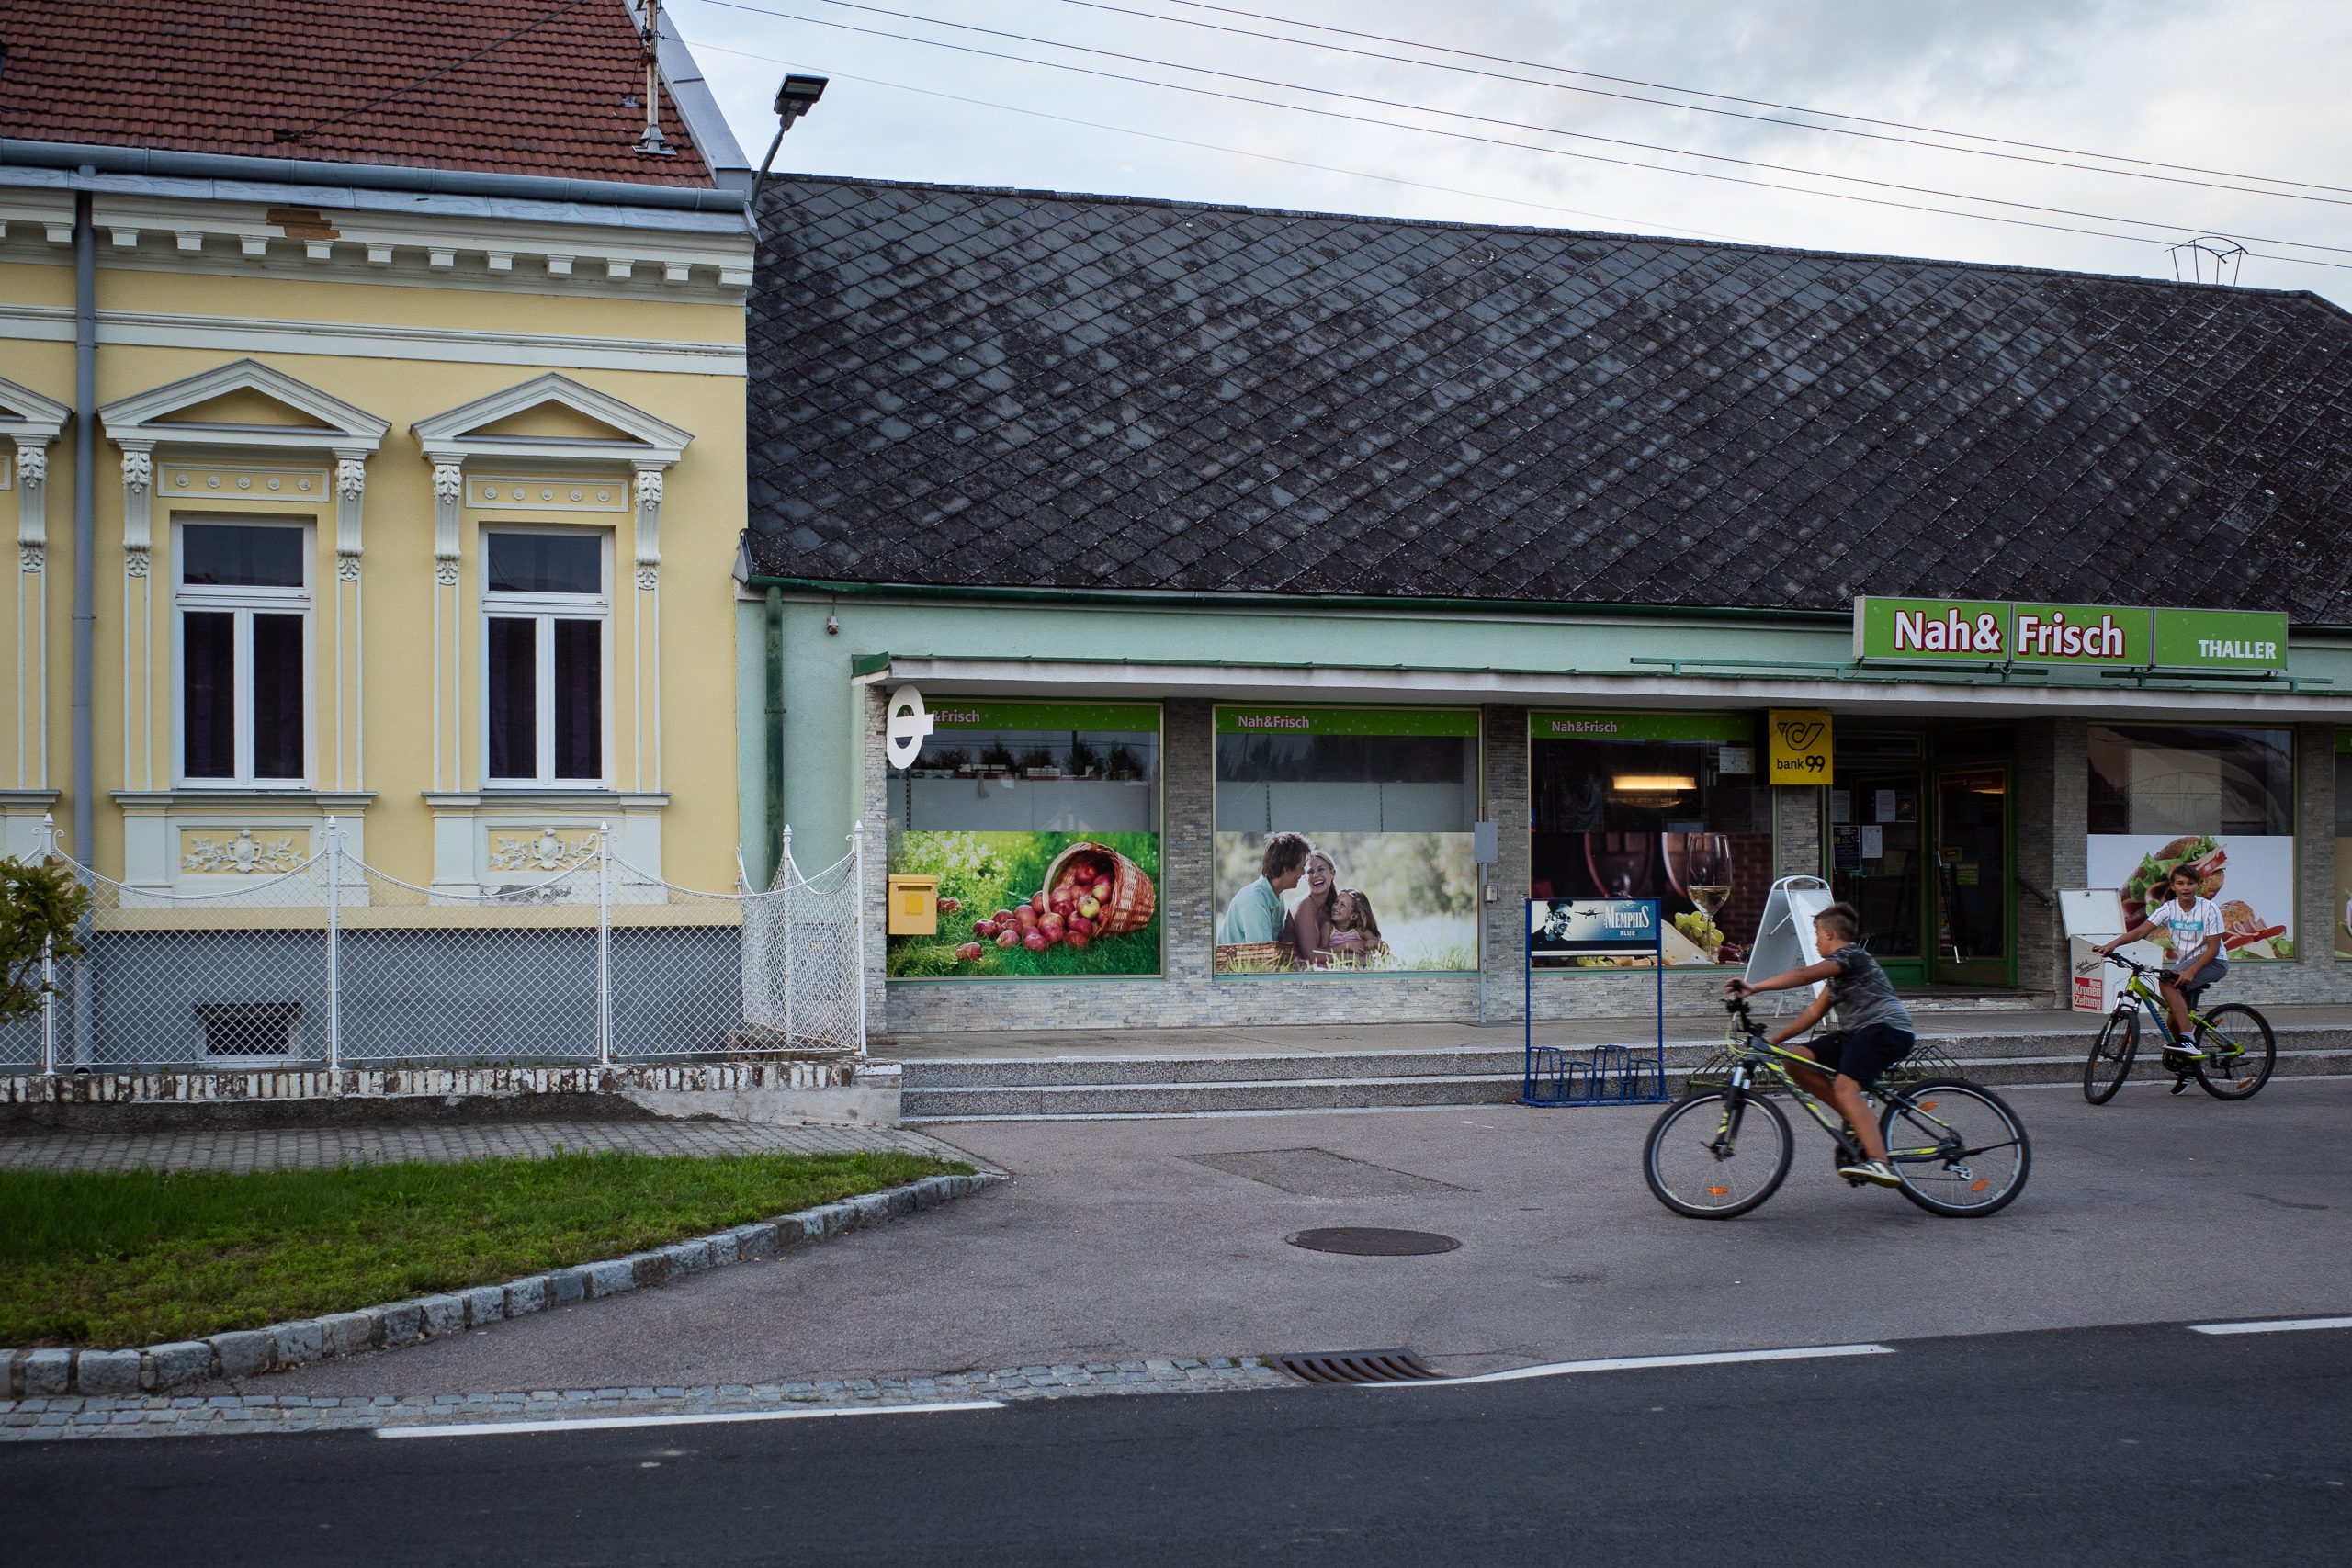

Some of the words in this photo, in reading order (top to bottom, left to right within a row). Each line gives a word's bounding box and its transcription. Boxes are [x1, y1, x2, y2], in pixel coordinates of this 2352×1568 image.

[1894, 608, 2003, 652] Nah&
[2018, 611, 2126, 658] Frisch
[2198, 639, 2277, 660] THALLER
[1238, 715, 1311, 729] Nah&Frisch
[1551, 720, 1618, 734] Nah&Frisch
[1776, 758, 1804, 771] bank
[1805, 755, 1826, 773] 99
[1605, 905, 1650, 929] MEMPHIS
[2075, 983, 2101, 998] Kronen
[2089, 979, 2101, 987] Neue
[2075, 995, 2101, 1010] Zeitung
